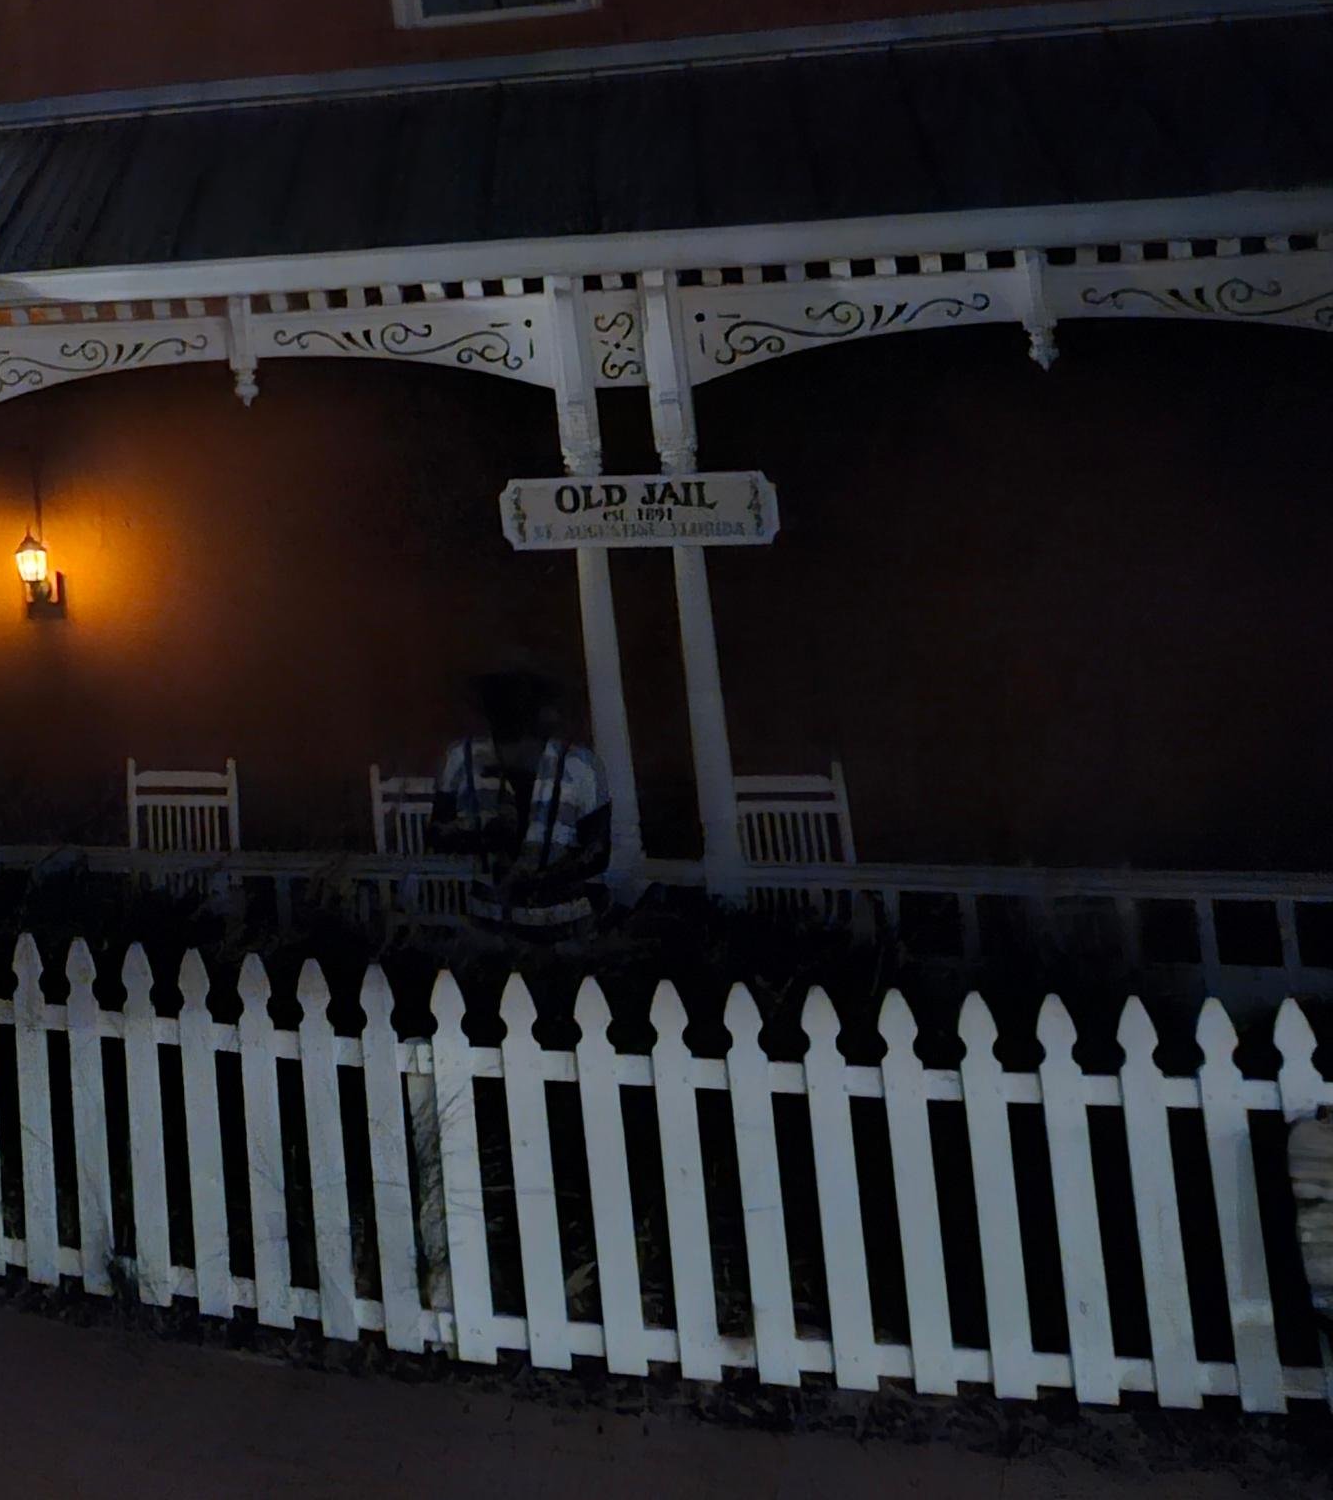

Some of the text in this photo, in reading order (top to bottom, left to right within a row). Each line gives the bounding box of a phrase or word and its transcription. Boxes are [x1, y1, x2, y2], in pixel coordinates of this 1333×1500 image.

[554, 481, 718, 514] OLD JAIL
[636, 507, 673, 521] 1891
